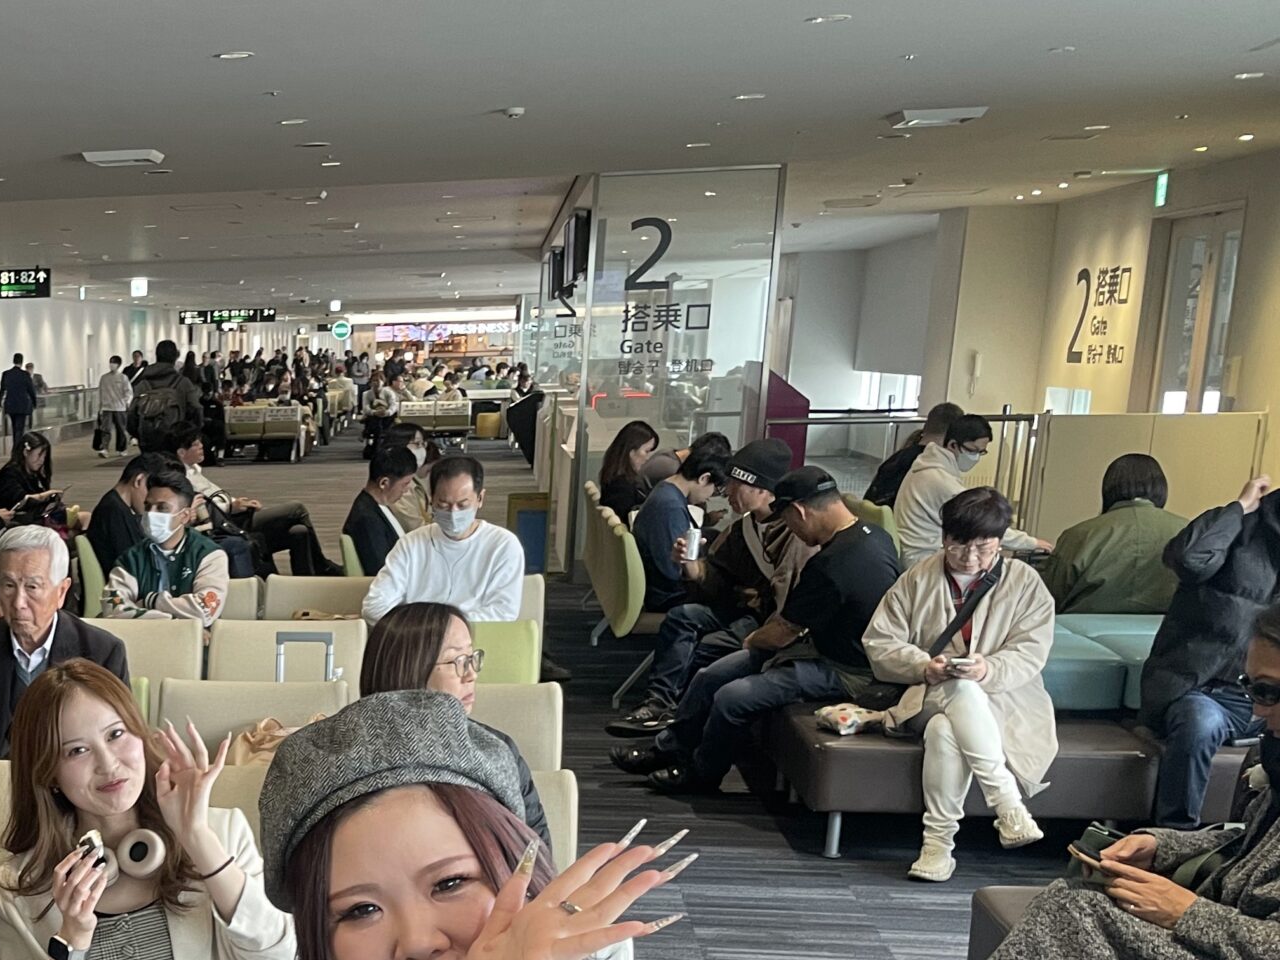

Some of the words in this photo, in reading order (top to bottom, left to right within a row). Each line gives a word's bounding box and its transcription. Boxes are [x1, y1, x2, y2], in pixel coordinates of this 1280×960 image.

[624, 217, 672, 291] 2
[1094, 266, 1132, 306] 搭乗口
[622, 302, 711, 333] 搭乗口
[1067, 268, 1091, 363] 2
[620, 339, 663, 354] Gate
